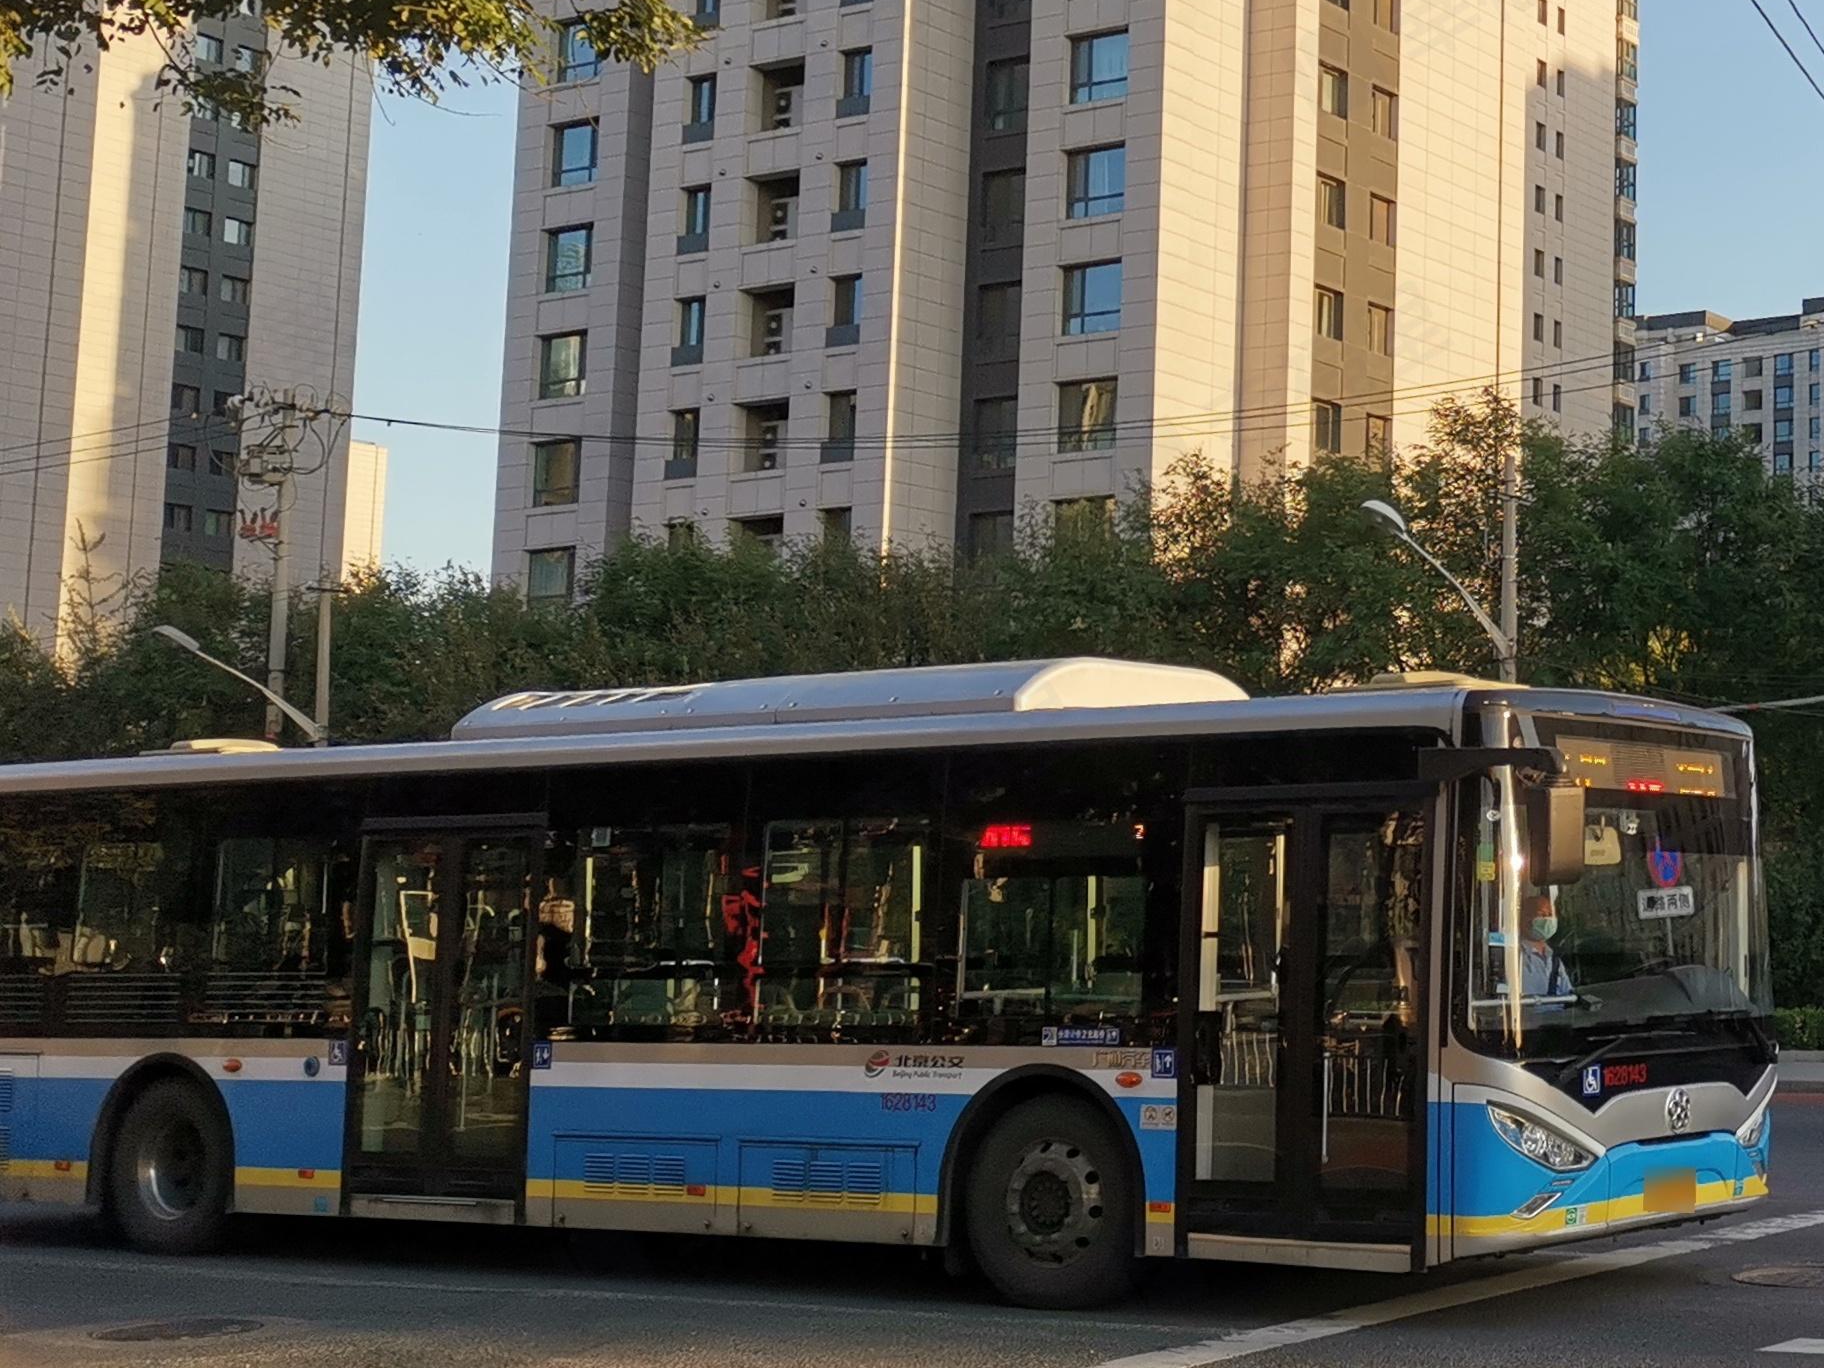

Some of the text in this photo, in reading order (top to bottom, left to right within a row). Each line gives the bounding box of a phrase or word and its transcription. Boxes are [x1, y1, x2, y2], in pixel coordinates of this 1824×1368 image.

[895, 1054, 965, 1068] 北京公交
[892, 1070, 912, 1079] Beijing
[1603, 1064, 1648, 1088] 1628143
[881, 1093, 937, 1112] 1628143
